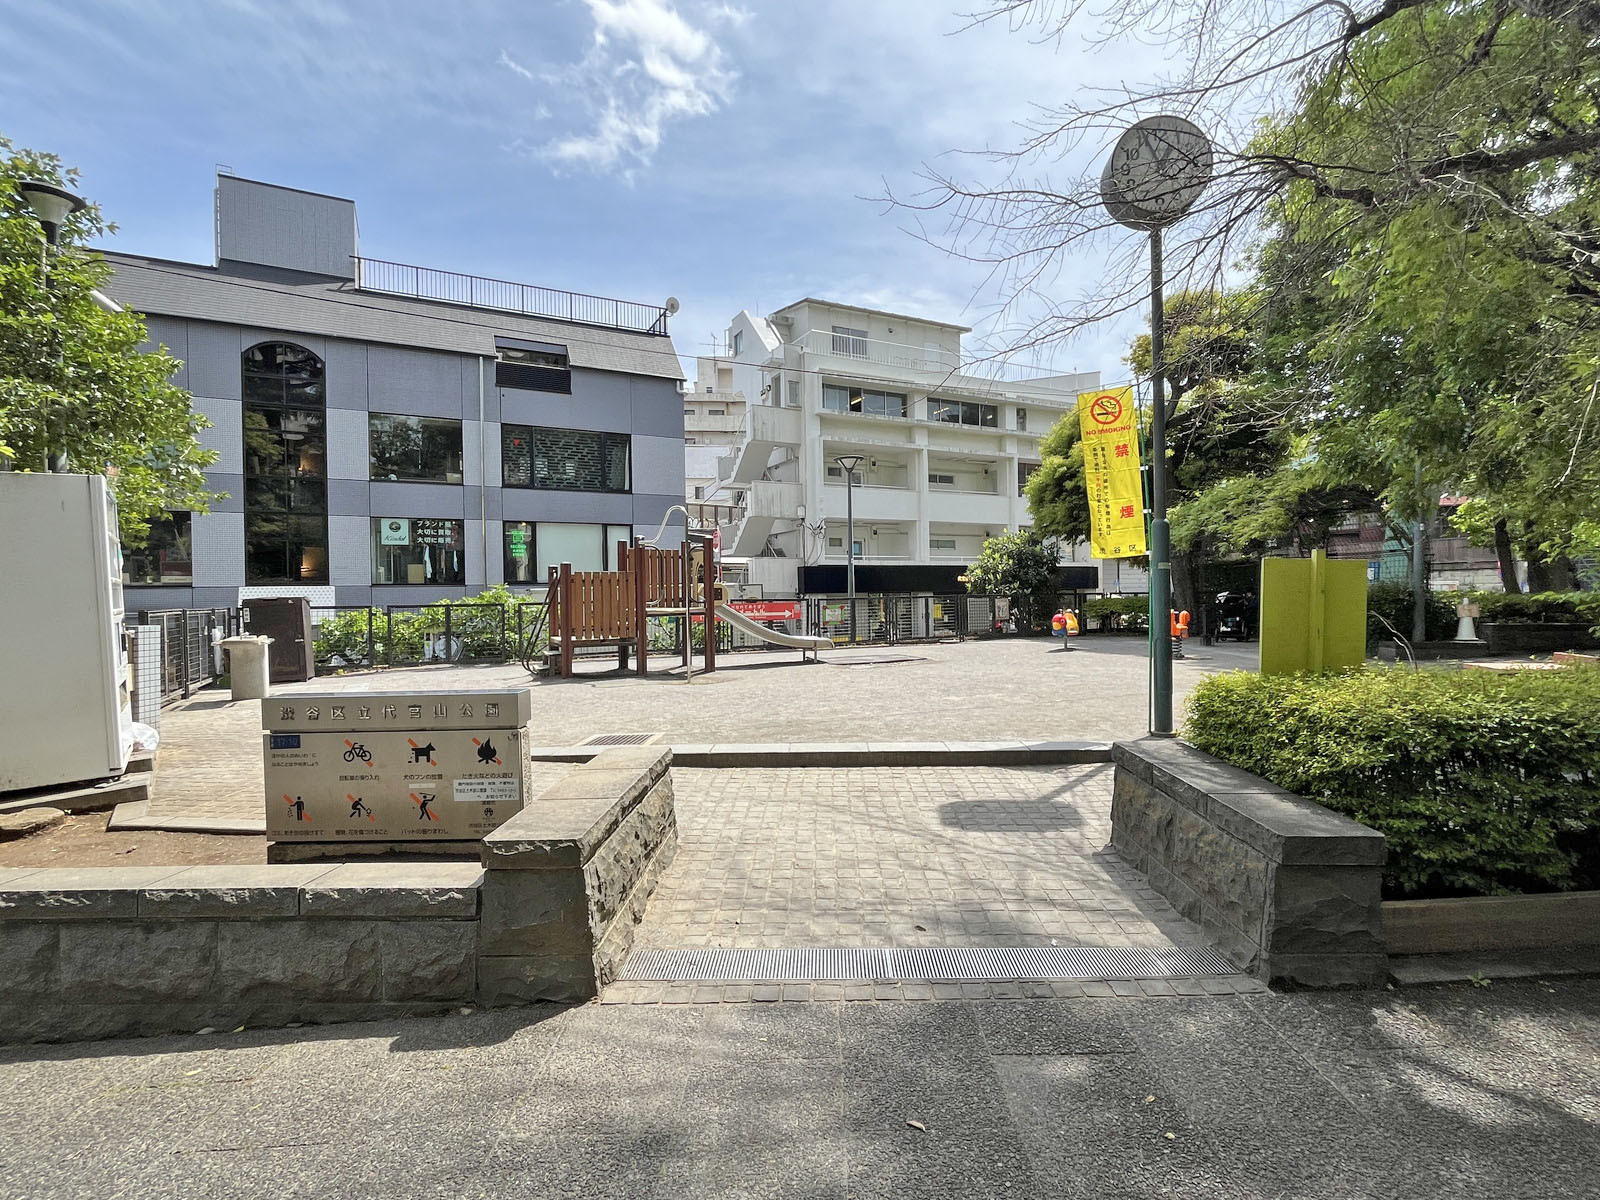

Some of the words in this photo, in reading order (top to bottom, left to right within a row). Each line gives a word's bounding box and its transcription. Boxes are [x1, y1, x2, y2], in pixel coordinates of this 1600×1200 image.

[1097, 424, 1131, 435] SMOKING
[280, 703, 500, 721] 渋谷区立代官山公園
